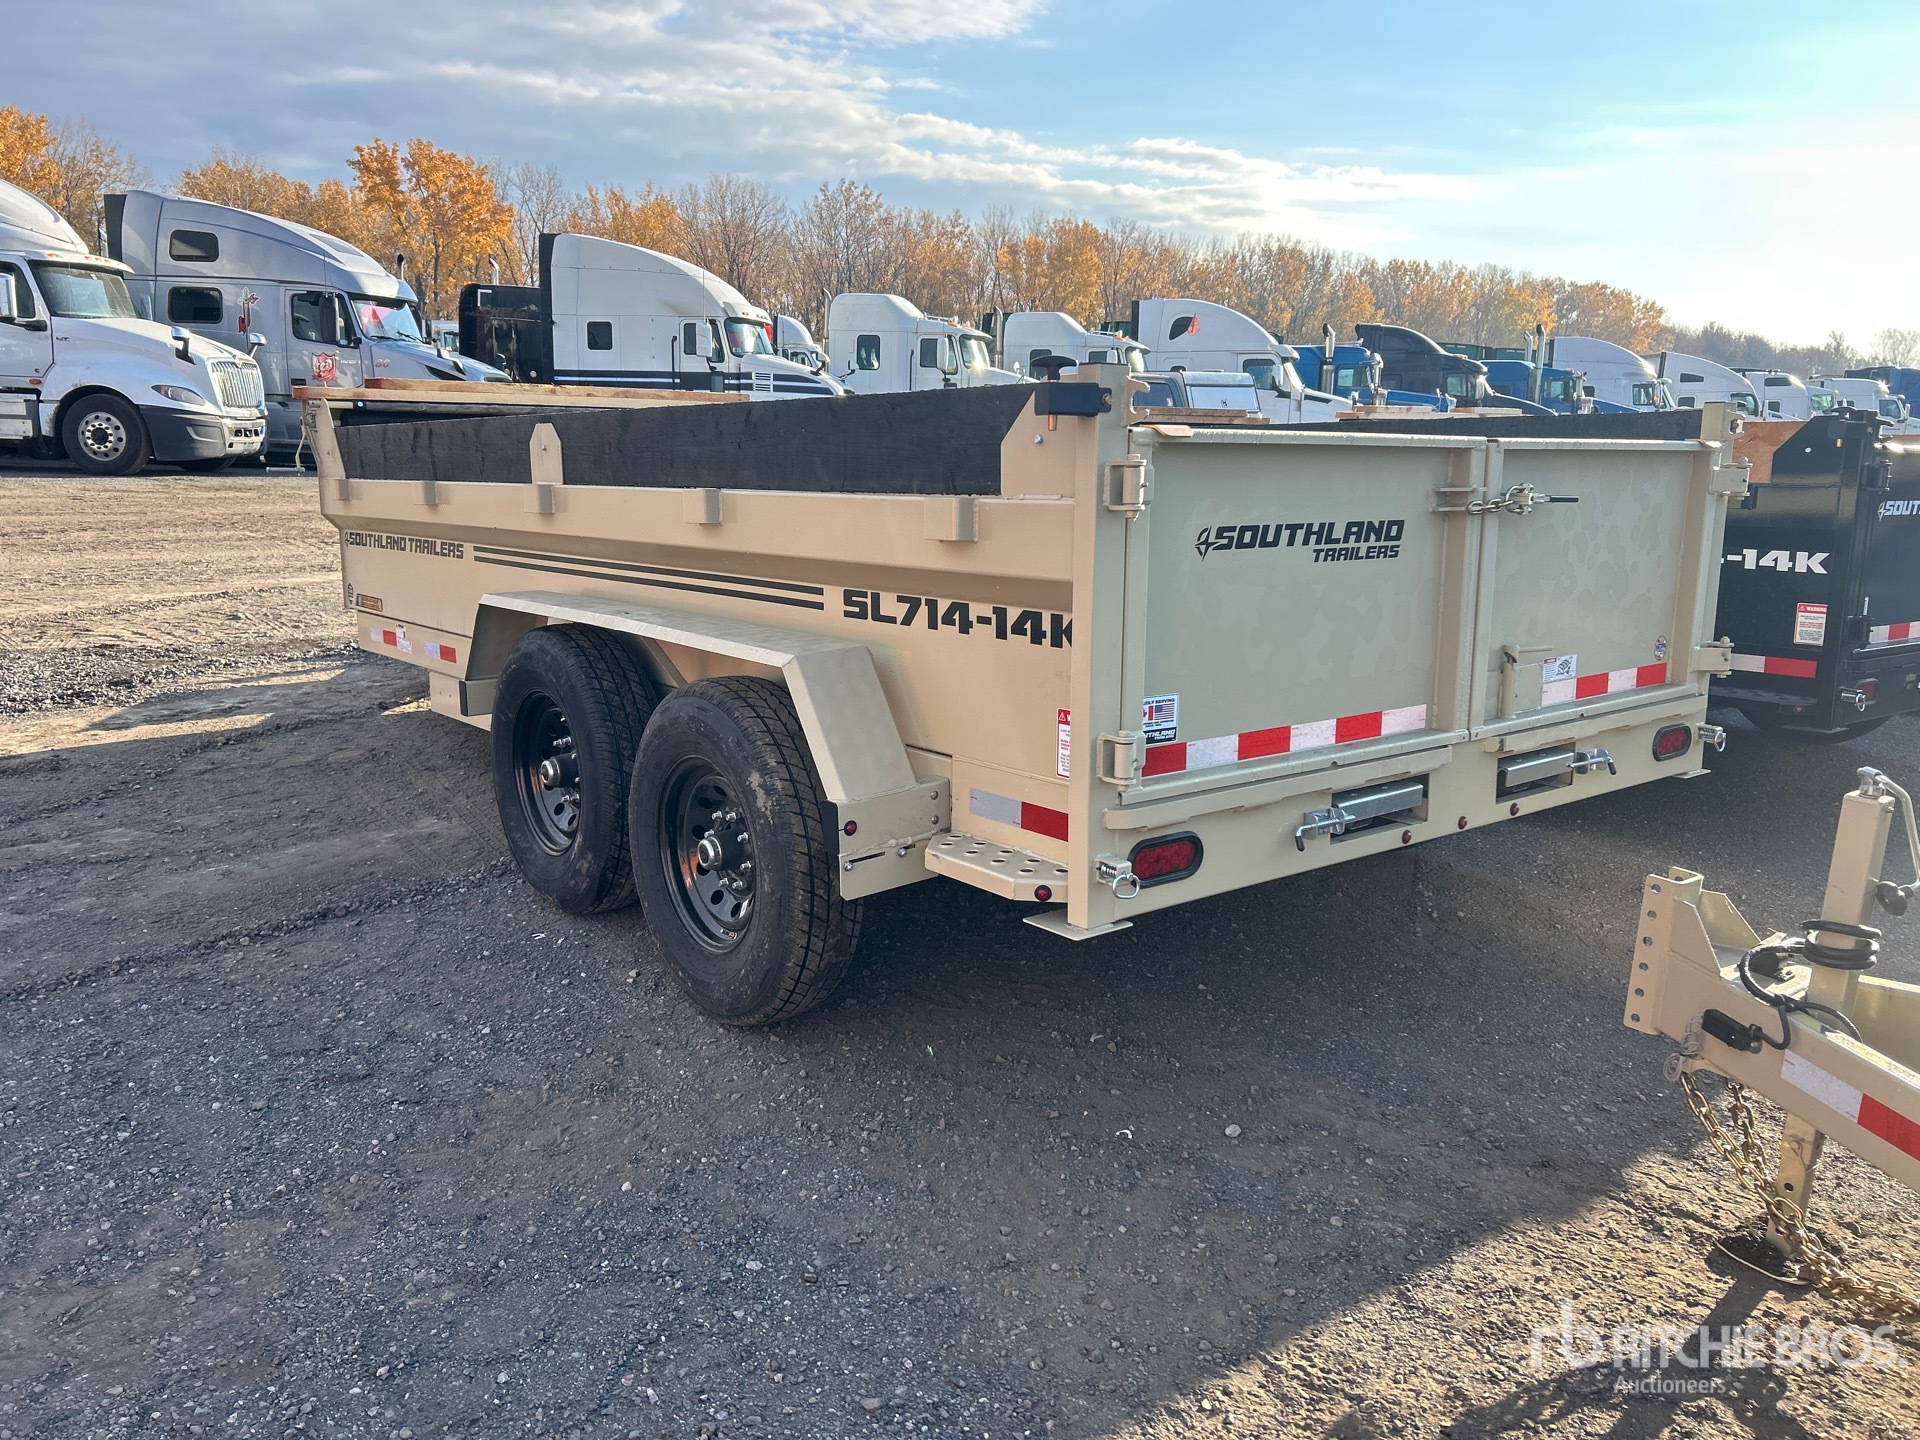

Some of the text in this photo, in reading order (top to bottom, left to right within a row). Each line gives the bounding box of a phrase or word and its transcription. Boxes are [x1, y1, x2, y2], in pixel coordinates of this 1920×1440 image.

[1884, 500, 1920, 516] SOUT
[349, 532, 464, 559] SOUTHLAND TRAILERS
[1212, 520, 1405, 551] SOUTHLAND
[1312, 545, 1400, 563] TRAILERS
[1721, 548, 1830, 574] -14K
[843, 588, 1073, 649] SL714-14K
